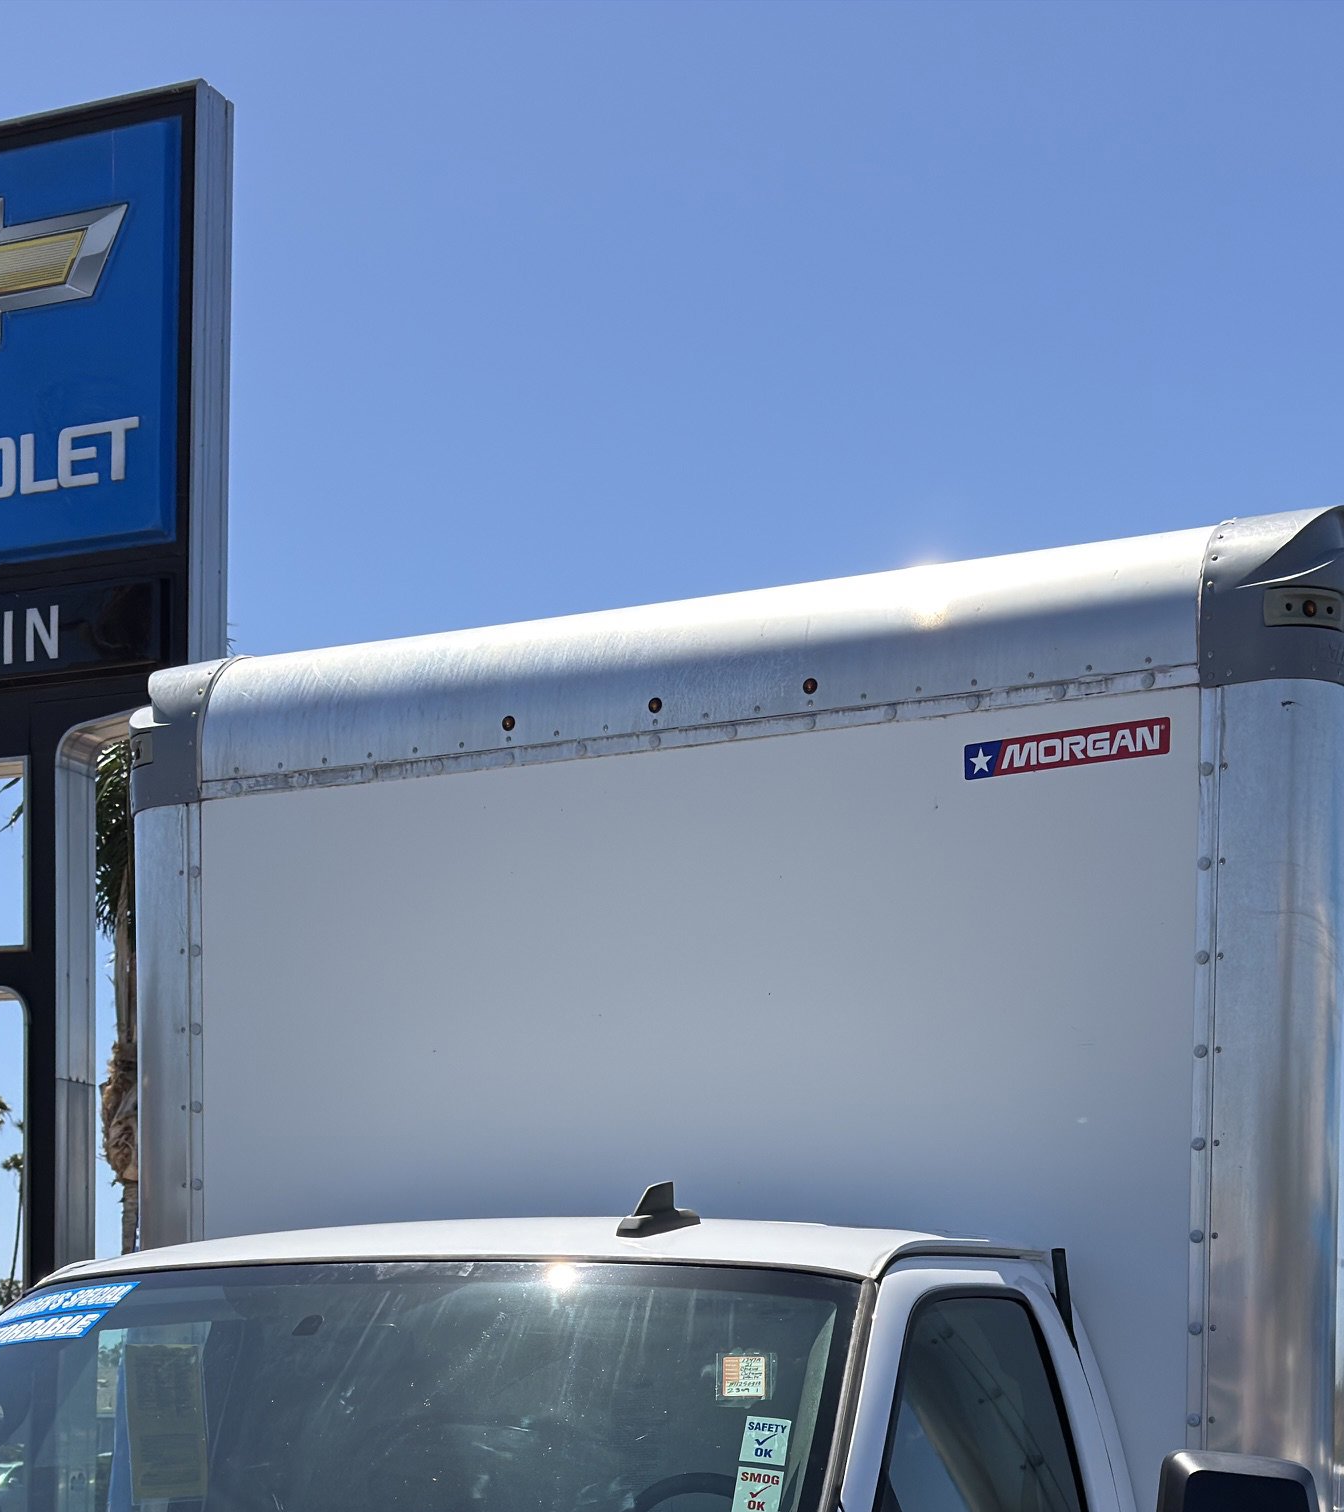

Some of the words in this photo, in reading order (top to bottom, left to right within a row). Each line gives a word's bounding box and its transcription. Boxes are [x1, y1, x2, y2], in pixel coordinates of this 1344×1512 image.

[1000, 724, 1161, 770] MORGAN
[65, 1284, 134, 1306] SPECIAL
[747, 1421, 787, 1434] SAFETY
[754, 1447, 773, 1459] OK
[740, 1471, 780, 1485] SMOG
[746, 1500, 766, 1512] OK
